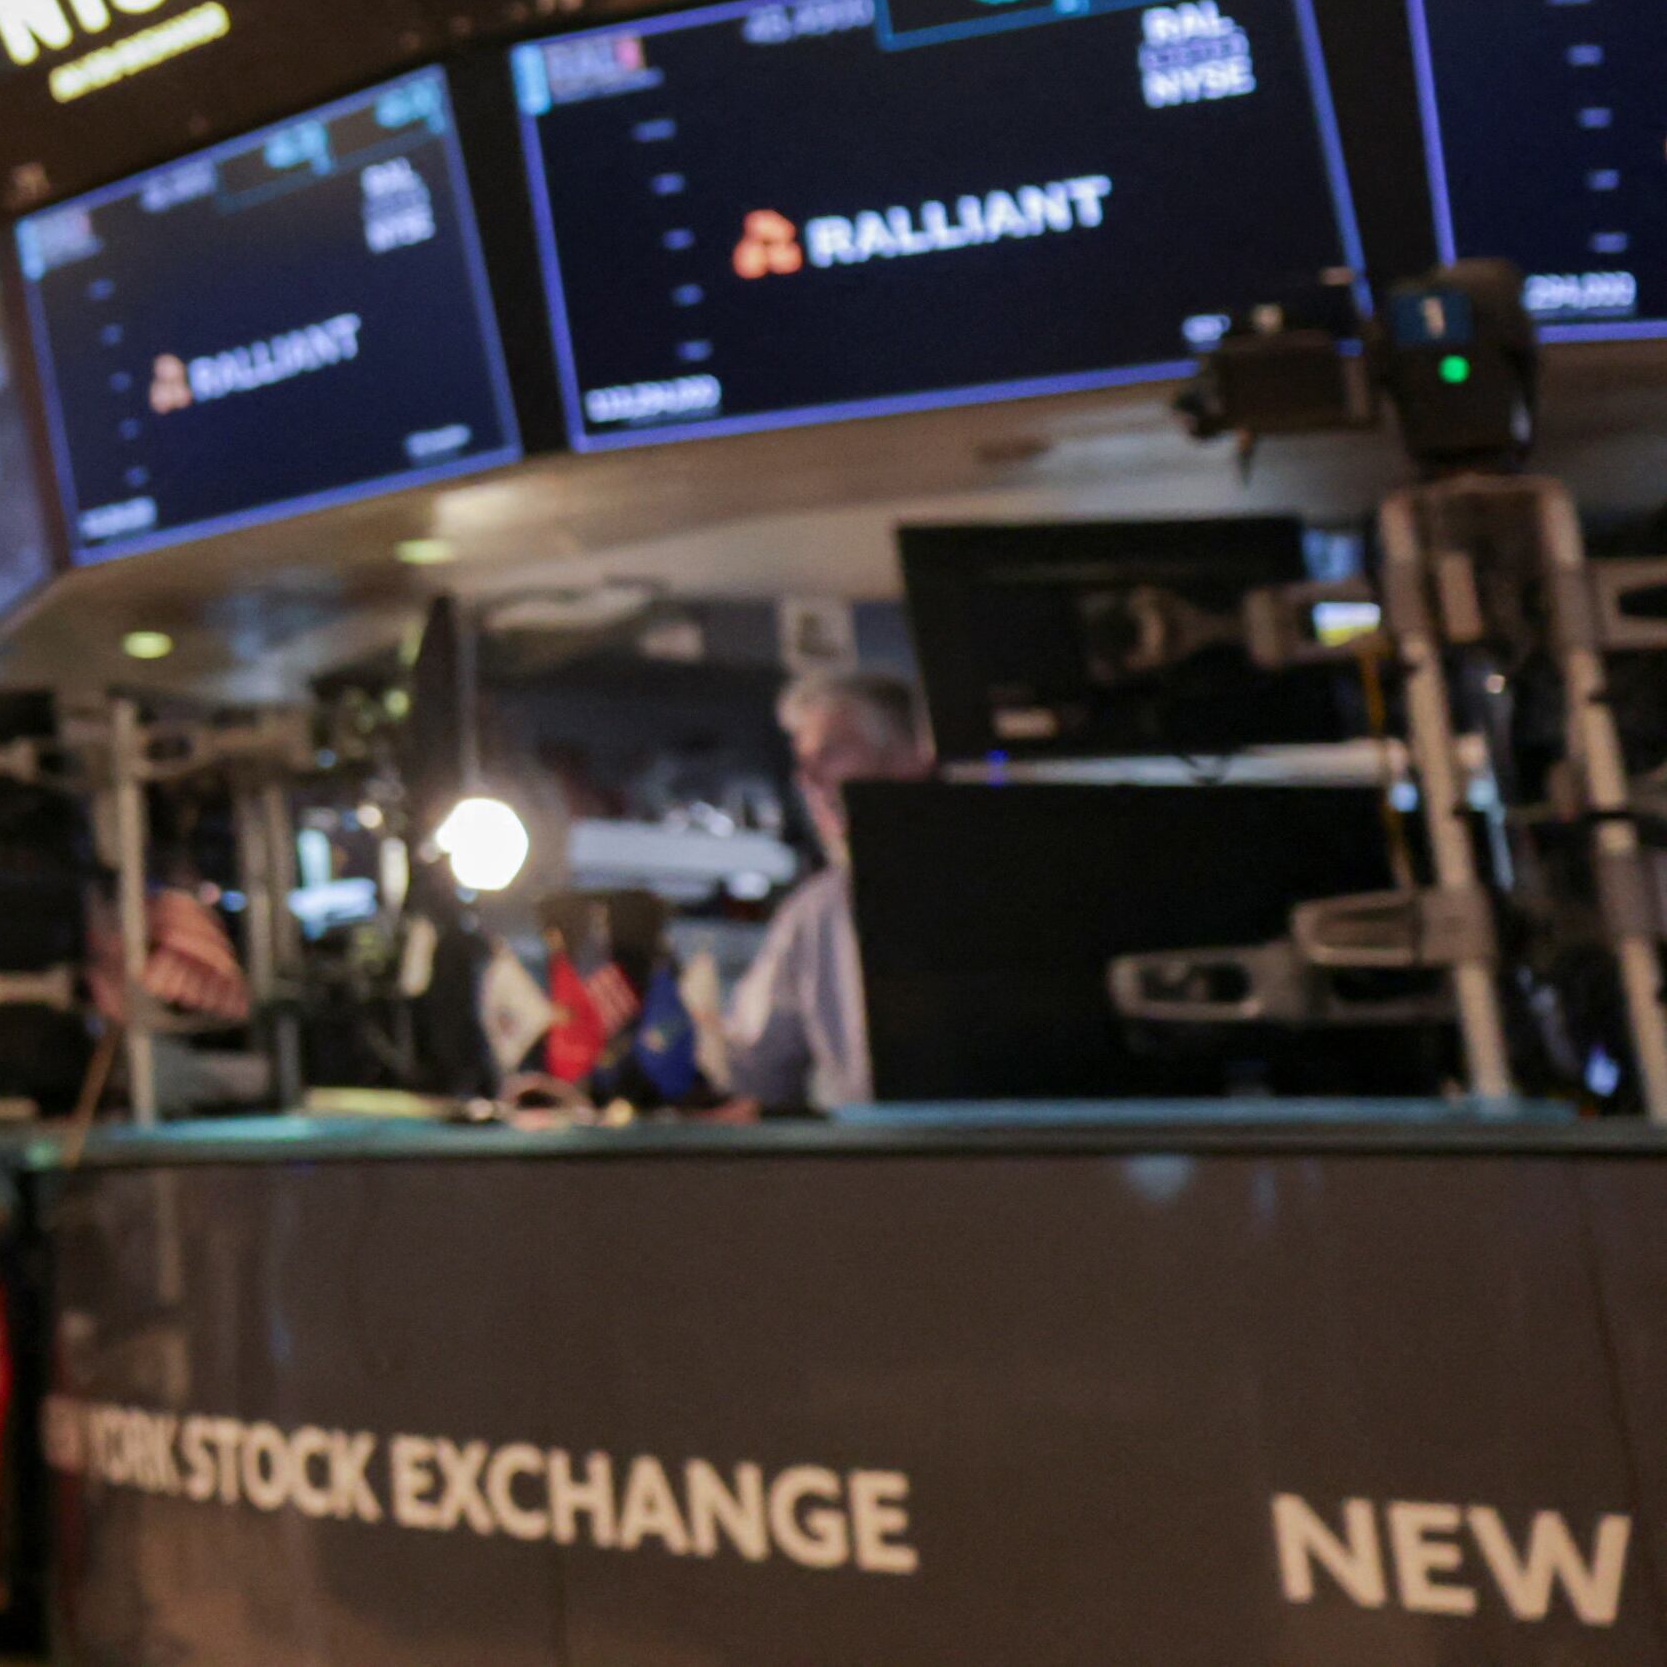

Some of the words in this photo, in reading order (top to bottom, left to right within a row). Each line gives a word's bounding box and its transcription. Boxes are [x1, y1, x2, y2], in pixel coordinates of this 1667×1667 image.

[806, 175, 1112, 267] RALLIANT
[188, 312, 362, 402] RALLIANT
[183, 1413, 383, 1525] STOCK
[390, 1430, 919, 1574] EXCHANGE
[1270, 1491, 1631, 1626] NEW
